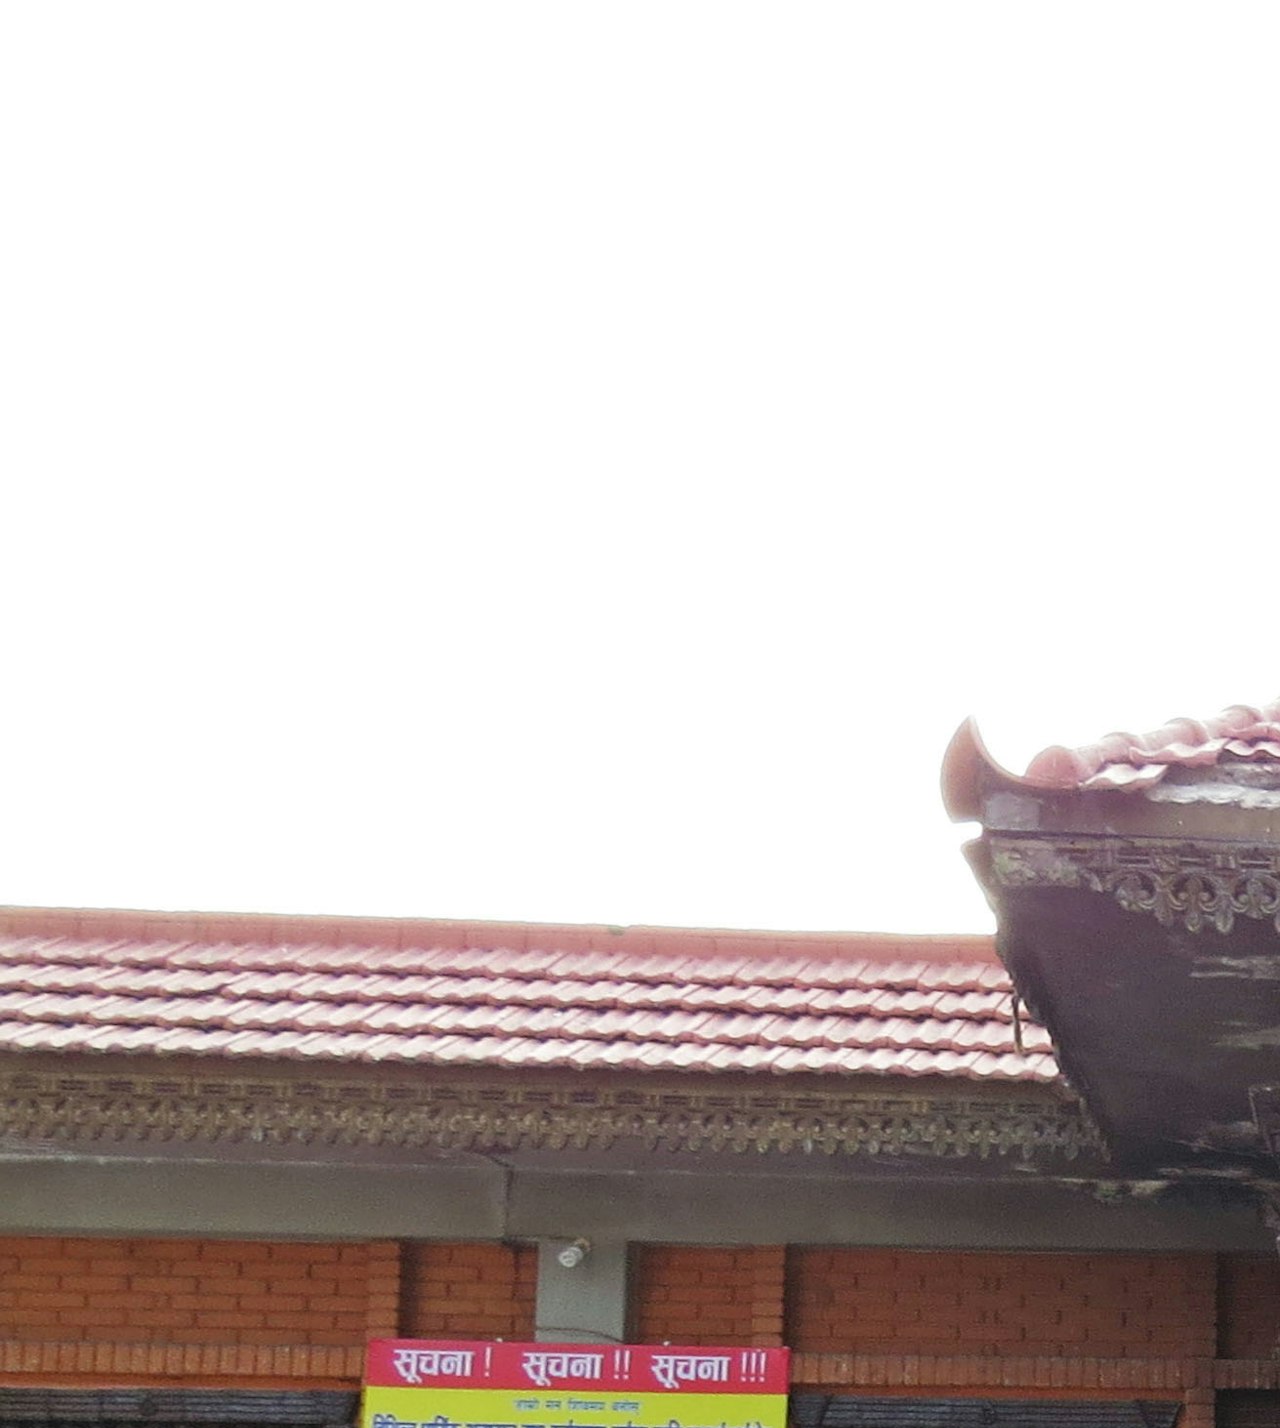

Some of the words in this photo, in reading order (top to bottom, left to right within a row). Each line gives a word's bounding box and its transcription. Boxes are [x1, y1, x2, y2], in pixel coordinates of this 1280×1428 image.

[393, 1349, 475, 1384] सूचना
[522, 1351, 603, 1386] सूचना
[651, 1352, 730, 1388] सूचना
